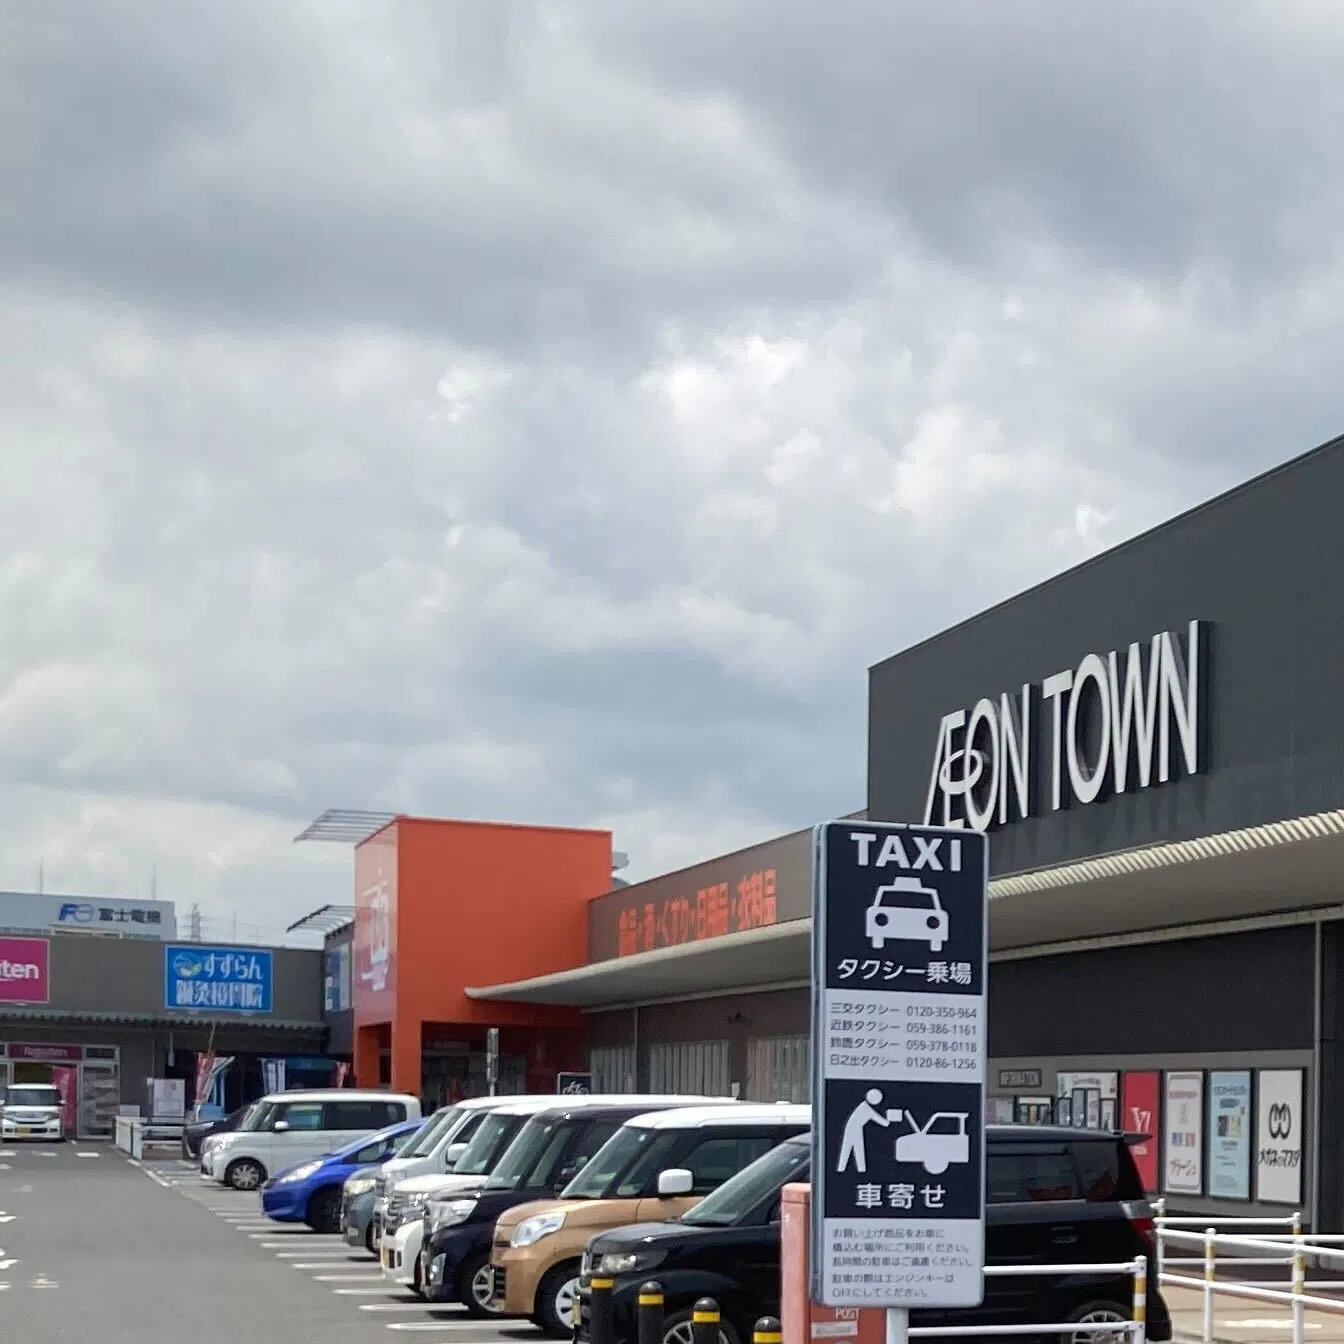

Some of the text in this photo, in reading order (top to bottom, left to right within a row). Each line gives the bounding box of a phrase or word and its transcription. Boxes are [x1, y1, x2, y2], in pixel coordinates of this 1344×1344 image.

[1042, 619, 1199, 804] TOWN
[850, 832, 961, 872] TAXI
[0, 960, 39, 980] ten
[203, 953, 263, 980] すずらん
[837, 959, 972, 985] タクシー乗場
[831, 1002, 900, 1015] 三交タクシー
[830, 1019, 901, 1032] 近鉄タクシー
[830, 1036, 901, 1049] 鈴鹿タクシー
[830, 1054, 900, 1067] 日之出タクシー
[855, 1182, 946, 1210] 車寄せ
